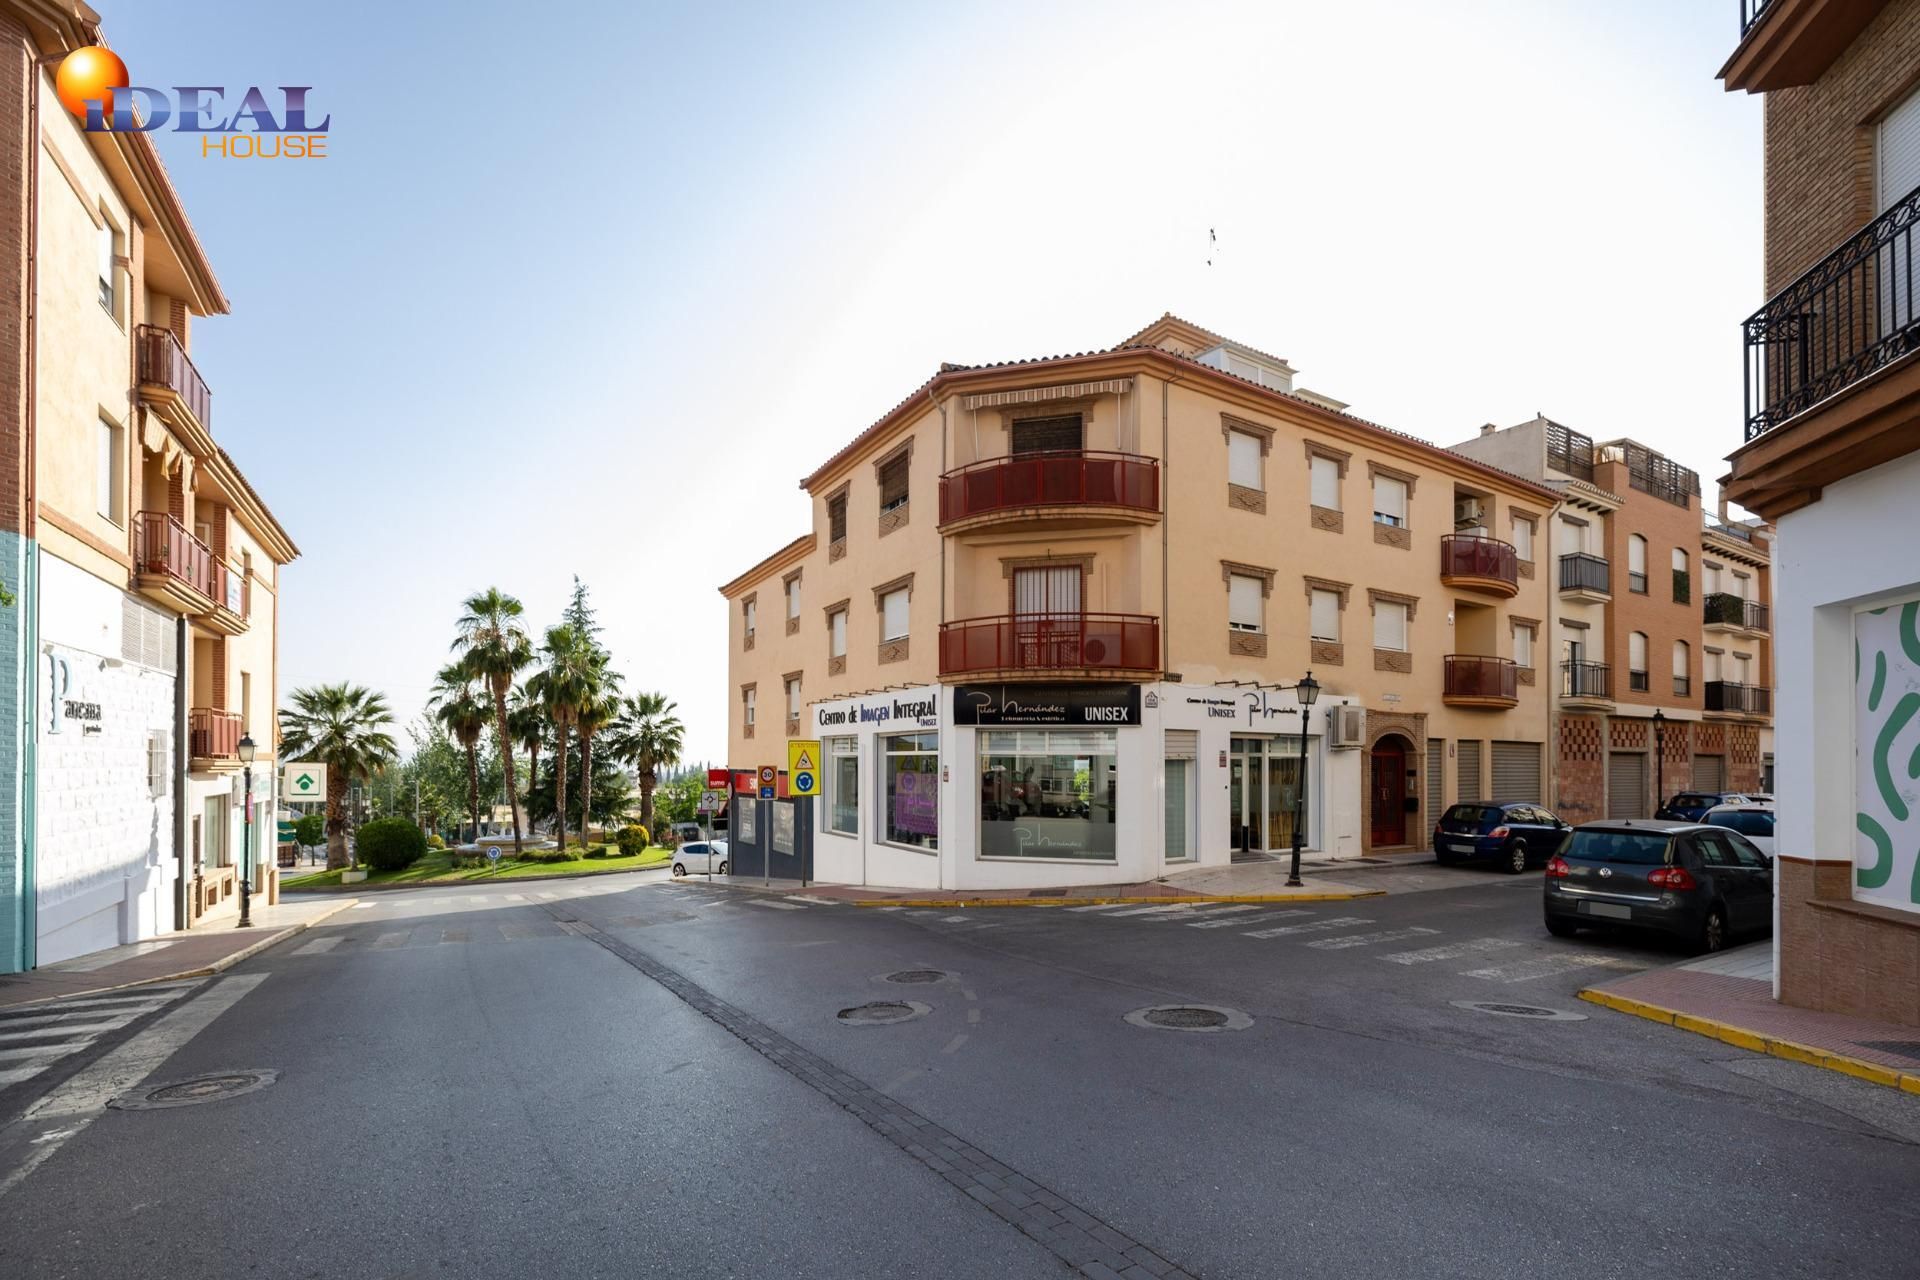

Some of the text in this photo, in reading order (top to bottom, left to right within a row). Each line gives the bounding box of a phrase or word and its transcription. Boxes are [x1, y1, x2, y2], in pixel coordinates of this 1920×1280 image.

[1084, 706, 1129, 721] UNISEX
[1208, 707, 1235, 718] UNISEX
[920, 718, 937, 727] UNISEX
